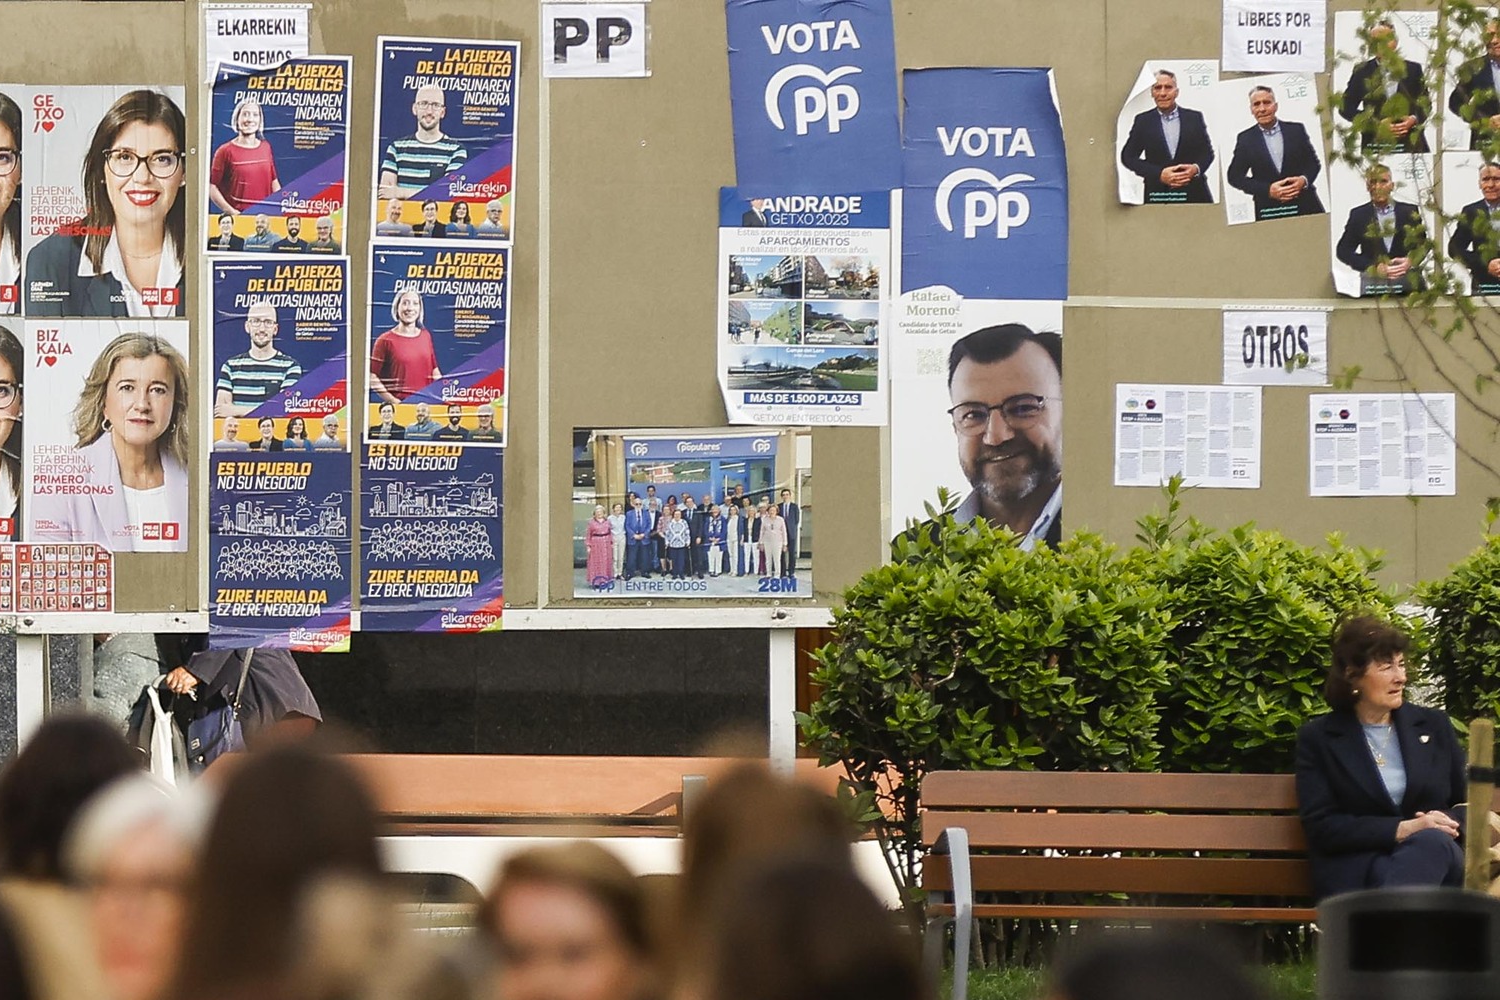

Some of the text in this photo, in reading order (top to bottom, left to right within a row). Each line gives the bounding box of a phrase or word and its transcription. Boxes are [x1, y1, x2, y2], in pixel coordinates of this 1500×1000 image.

[1238, 12, 1311, 28] LIBRES POR
[217, 18, 296, 36] ELKARREKIN
[553, 17, 632, 64] PP
[760, 20, 860, 54] VOTA
[1247, 40, 1301, 56] EUSKADI
[445, 48, 511, 64] LA FUERZA
[276, 64, 343, 78] LA FUERZA
[463, 92, 510, 106] INDARRA
[34, 108, 64, 120] TXO
[295, 107, 342, 120] INDARRA
[936, 126, 1035, 158] VOTA
[31, 186, 74, 195] LEHENIK
[449, 180, 507, 192] elkarrekin
[282, 196, 340, 210] elkarrekin
[761, 196, 862, 214] ANDRADE
[31, 216, 82, 225] PRIMERO
[770, 214, 849, 226] GETXO 2023
[760, 237, 850, 246] APARCAMIENTOS
[436, 252, 503, 266] LA FUERZA
[276, 266, 342, 278] LA FUERZA
[248, 279, 265, 292] DE
[266, 279, 283, 292] LO
[454, 295, 502, 308] INDARRA
[295, 308, 342, 320] INDARRA
[906, 305, 955, 316] Moreno
[37, 330, 58, 342] BIZ
[37, 342, 72, 354] KAIA
[1242, 324, 1308, 368] OTROS
[442, 384, 500, 396] elkarrekin
[284, 396, 342, 408] elkarrekin
[775, 394, 789, 403] DE
[816, 395, 859, 404] PLAZAS
[34, 465, 94, 474] PERTSONAK
[218, 462, 312, 476] ES TU PUEBLO
[368, 456, 458, 470] NO SU NEGOCIO
[34, 475, 84, 484] PRIMERO
[218, 476, 307, 490] NO SU NEGOCIO
[34, 486, 114, 494] LAS PERSONAS
[368, 570, 479, 583] ZURE HERRIA DA
[368, 584, 473, 598] EZ BERE NEGOZIOA
[626, 582, 664, 591] ENTRE
[667, 581, 707, 591] TODOS
[758, 578, 797, 592] 28M
[216, 590, 328, 604] ZURE HERRIA DA
[216, 603, 321, 616] EZ BERE NEGOZIOA
[441, 612, 497, 624] elkarrekin
